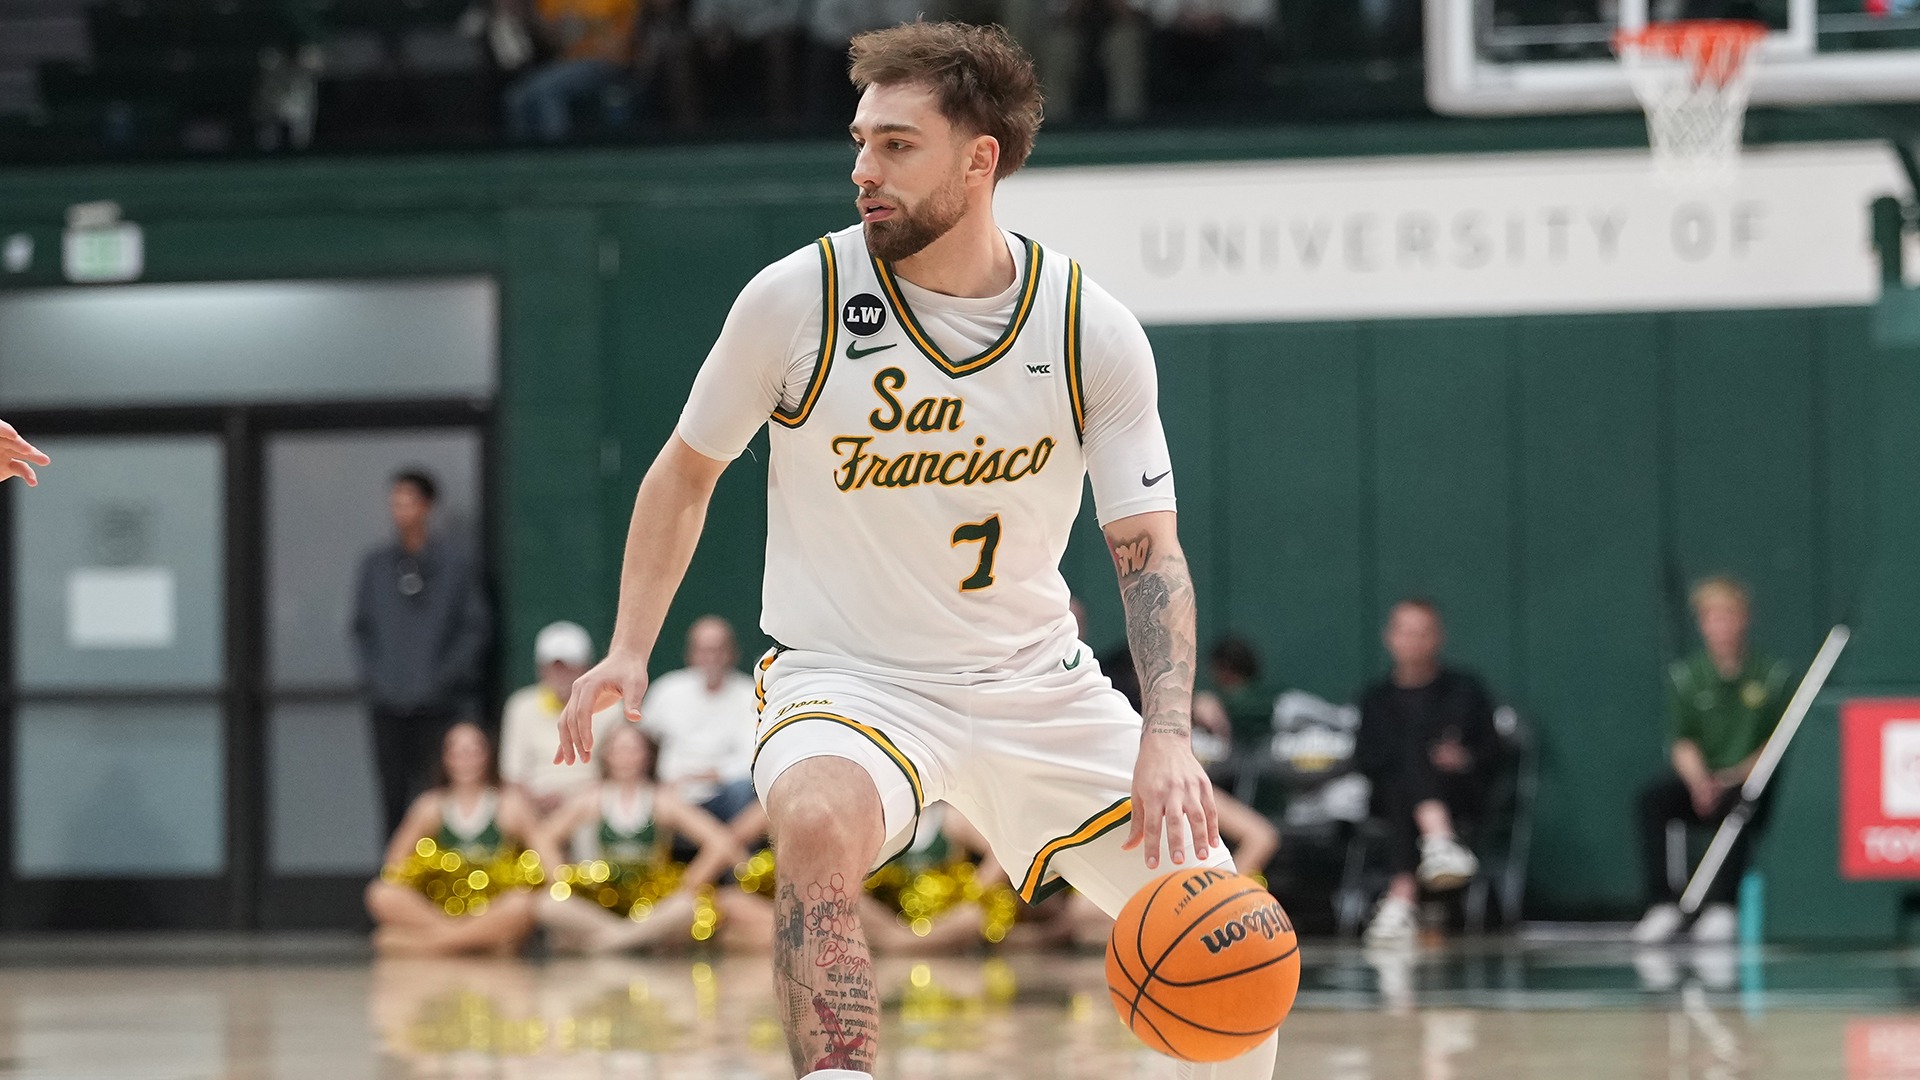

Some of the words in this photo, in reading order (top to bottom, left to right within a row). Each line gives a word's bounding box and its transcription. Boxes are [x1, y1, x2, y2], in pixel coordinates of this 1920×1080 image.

[1139, 205, 1629, 279] UNIVERSITY
[1668, 199, 1766, 263] OF
[847, 306, 882, 324] LW
[1026, 363, 1051, 374] WCC
[868, 366, 965, 434] San
[831, 434, 1057, 492] Francisco
[951, 513, 1002, 593] 7
[774, 699, 834, 720] Dons
[1200, 900, 1295, 954] Wilson
